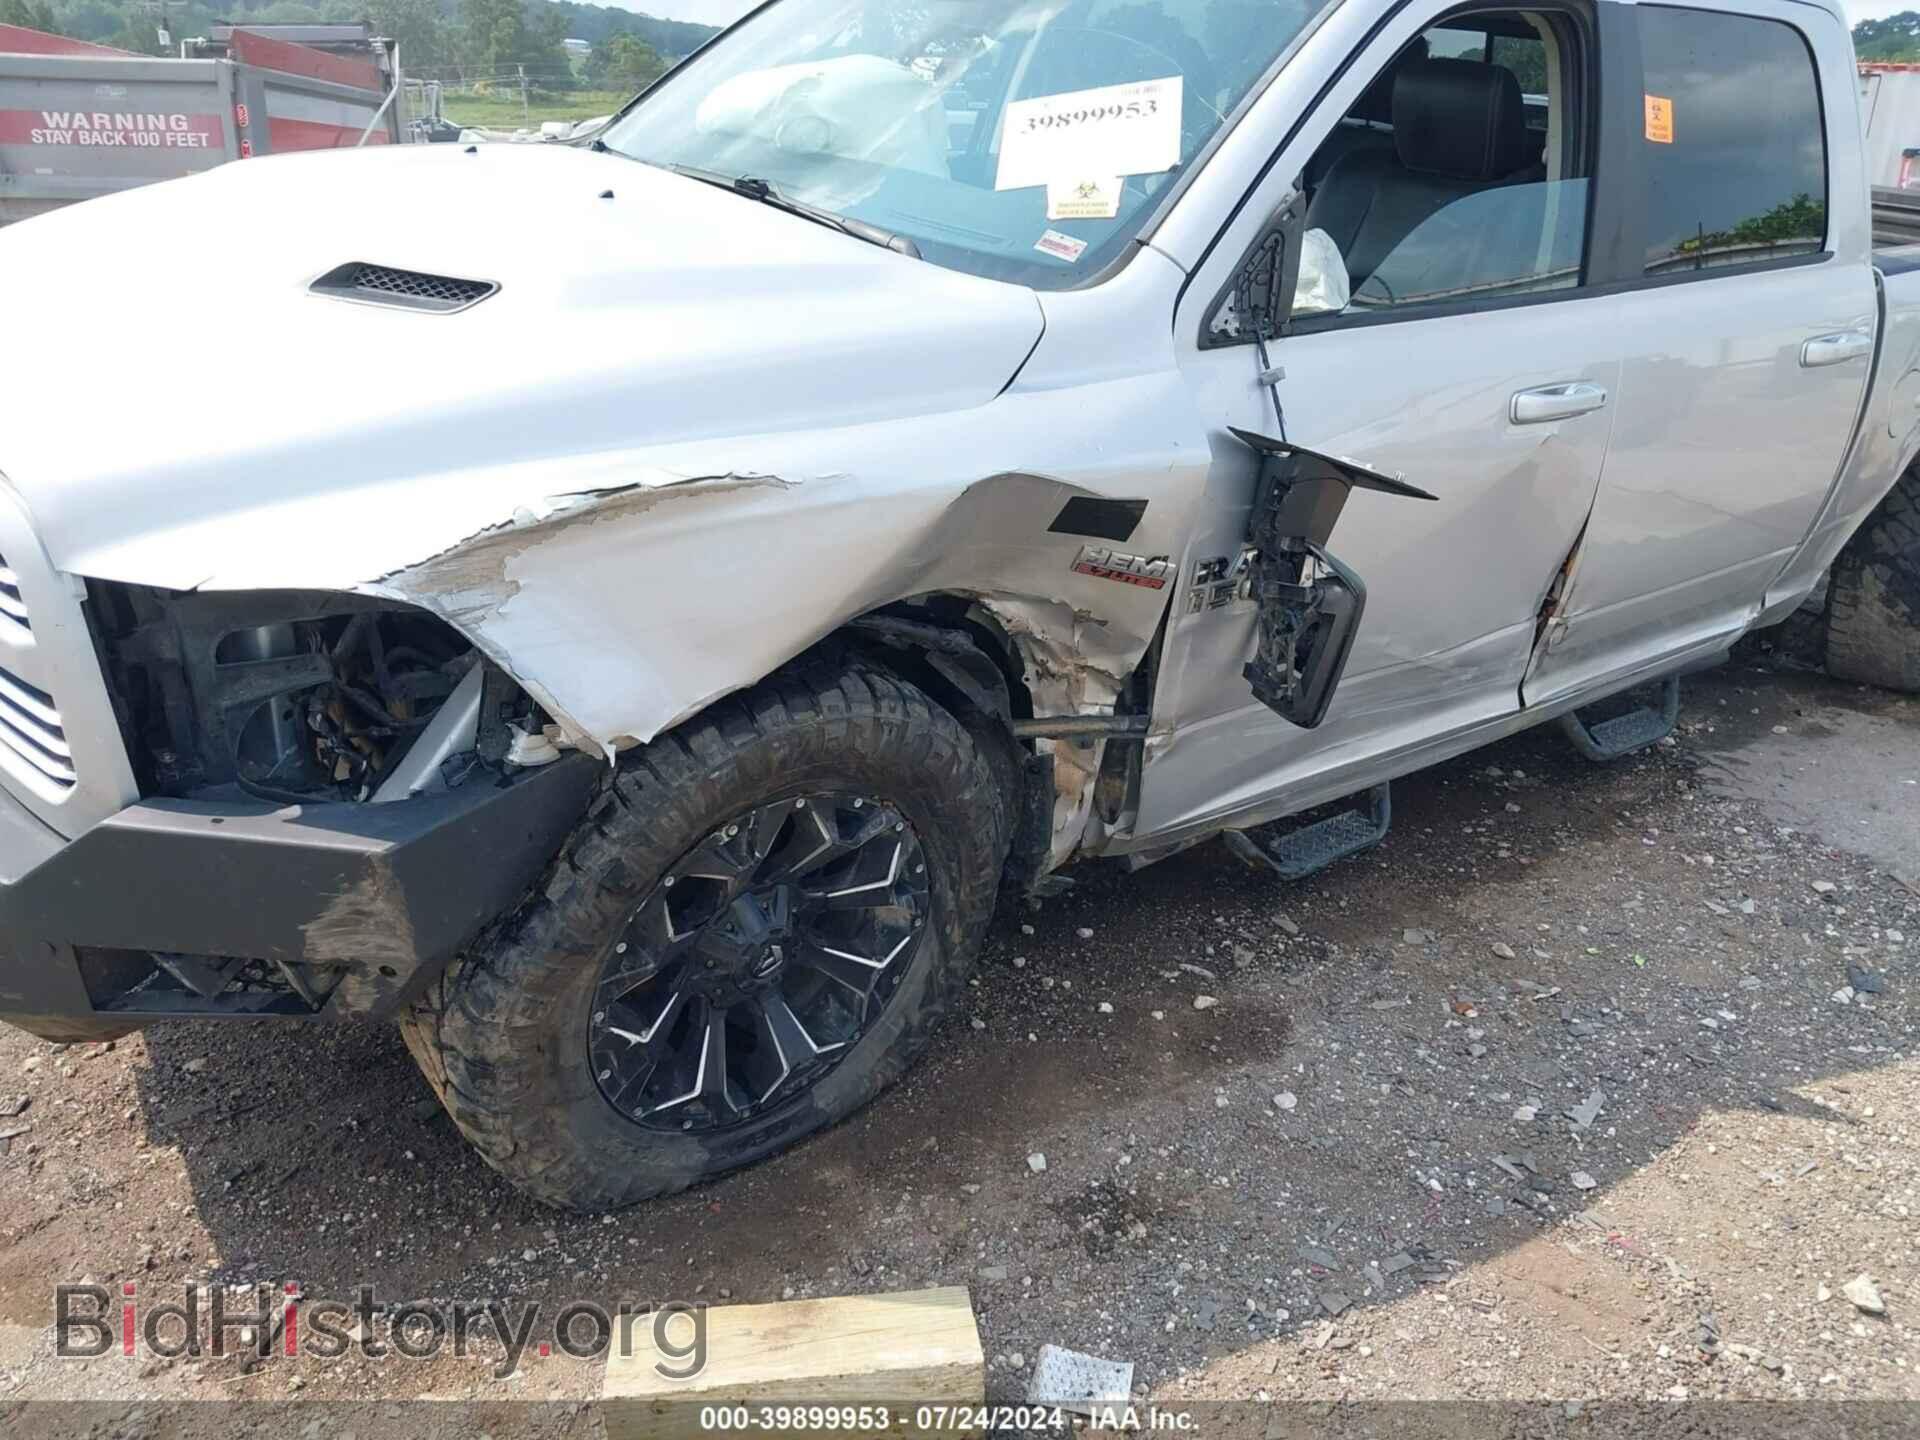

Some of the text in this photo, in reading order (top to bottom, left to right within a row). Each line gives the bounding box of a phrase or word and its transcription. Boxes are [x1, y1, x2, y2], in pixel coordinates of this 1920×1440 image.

[42, 111, 188, 131] WARNING
[1020, 99, 1158, 135] 39899953
[31, 128, 209, 147] STAY BACK 100 FEET
